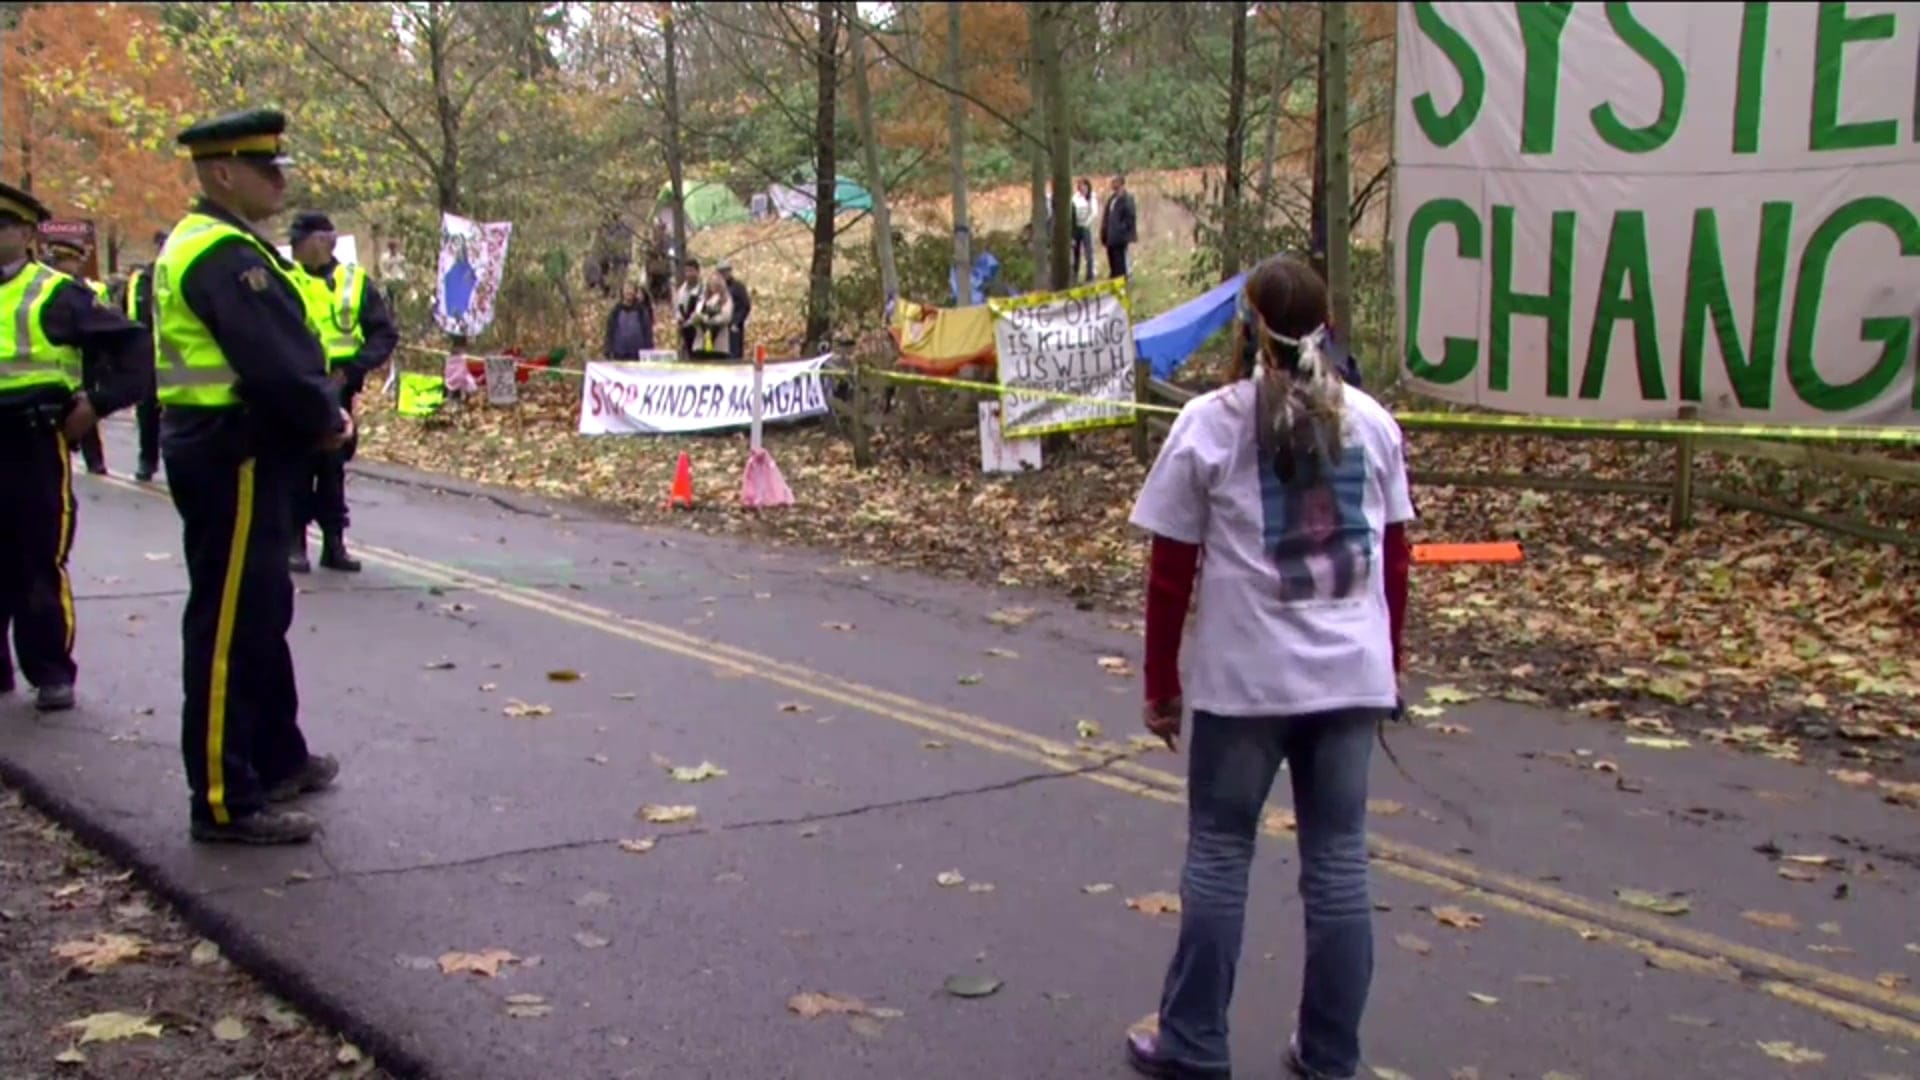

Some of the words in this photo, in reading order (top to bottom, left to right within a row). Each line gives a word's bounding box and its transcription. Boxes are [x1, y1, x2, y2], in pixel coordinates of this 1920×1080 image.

[1411, 2, 1919, 155] SYSTE
[1064, 294, 1108, 325] OIL
[1405, 196, 1919, 412] CHANG
[1007, 333, 1033, 356] IS
[1037, 318, 1125, 353] KILLING
[1017, 355, 1049, 381] US
[1052, 346, 1128, 378] WITH
[590, 378, 638, 417] STOP
[639, 383, 724, 418] KINDER
